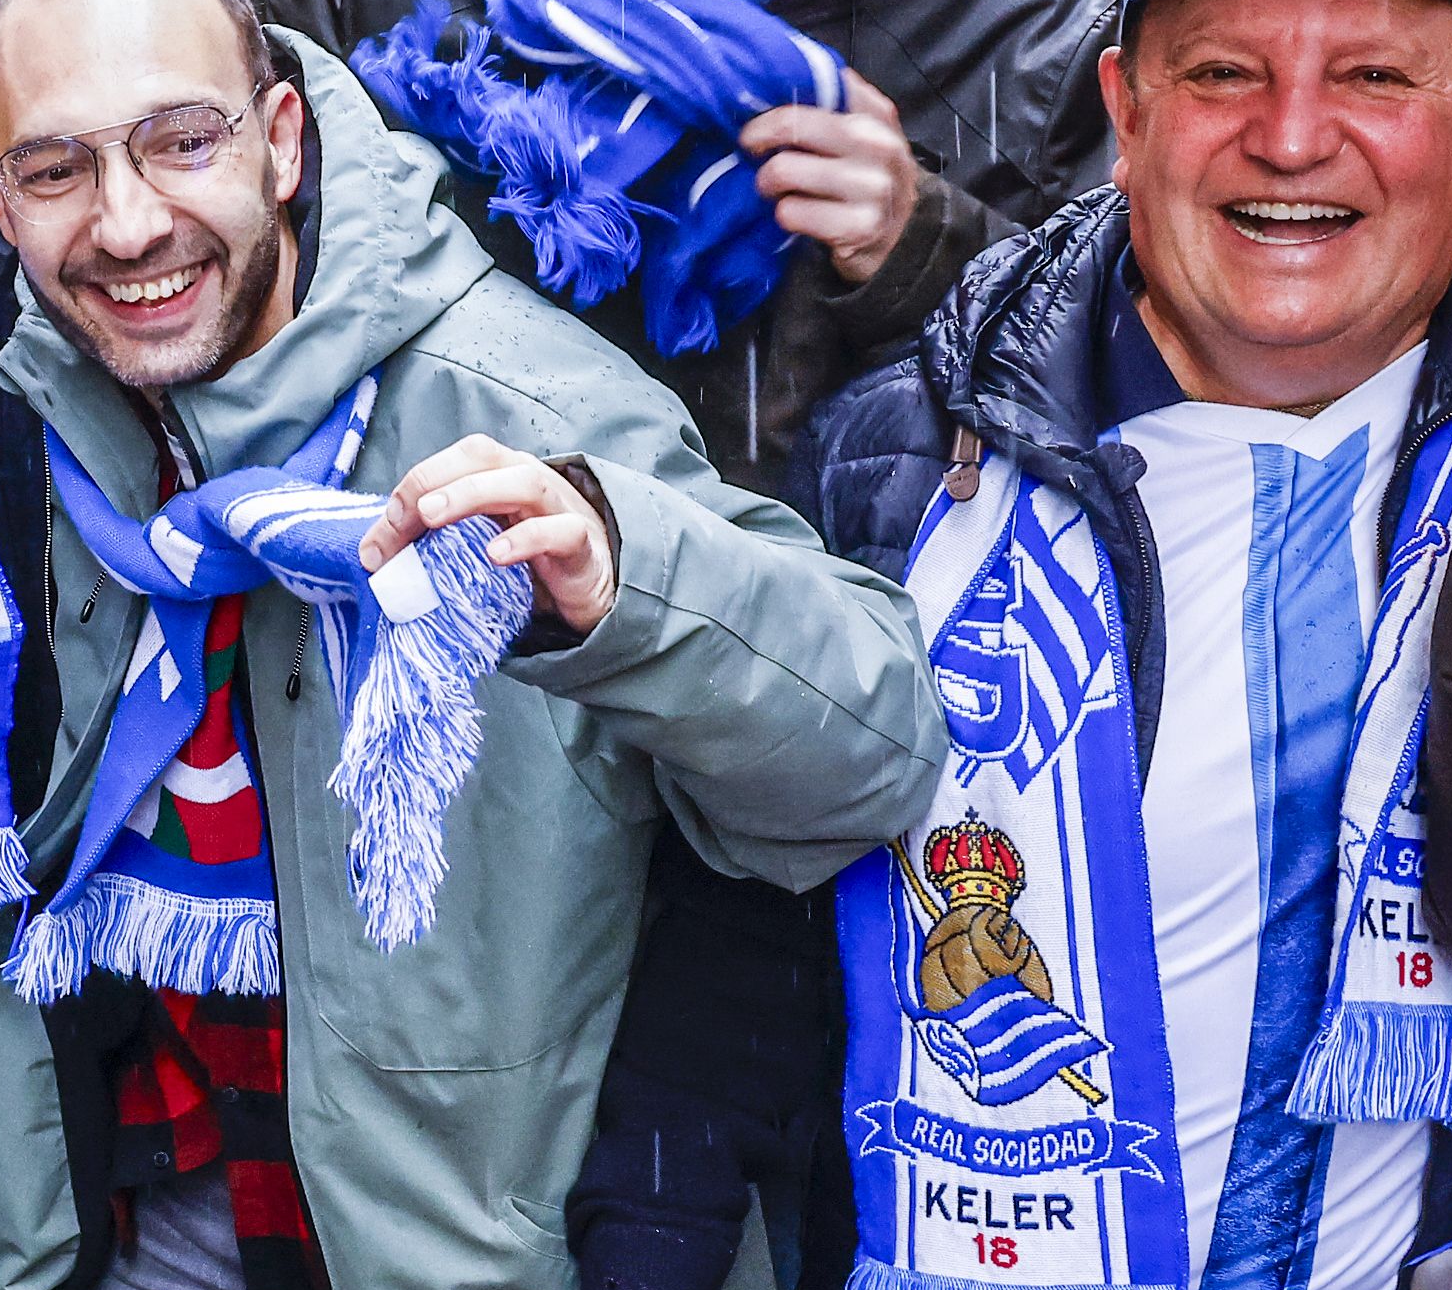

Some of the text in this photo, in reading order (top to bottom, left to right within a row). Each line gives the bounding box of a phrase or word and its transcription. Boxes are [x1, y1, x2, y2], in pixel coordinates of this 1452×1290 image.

[1395, 950, 1434, 988] 18
[911, 1115, 1096, 1170] REAL SOCIEDAD
[924, 1180, 1076, 1231] KELER
[972, 1232, 1020, 1269] 18
